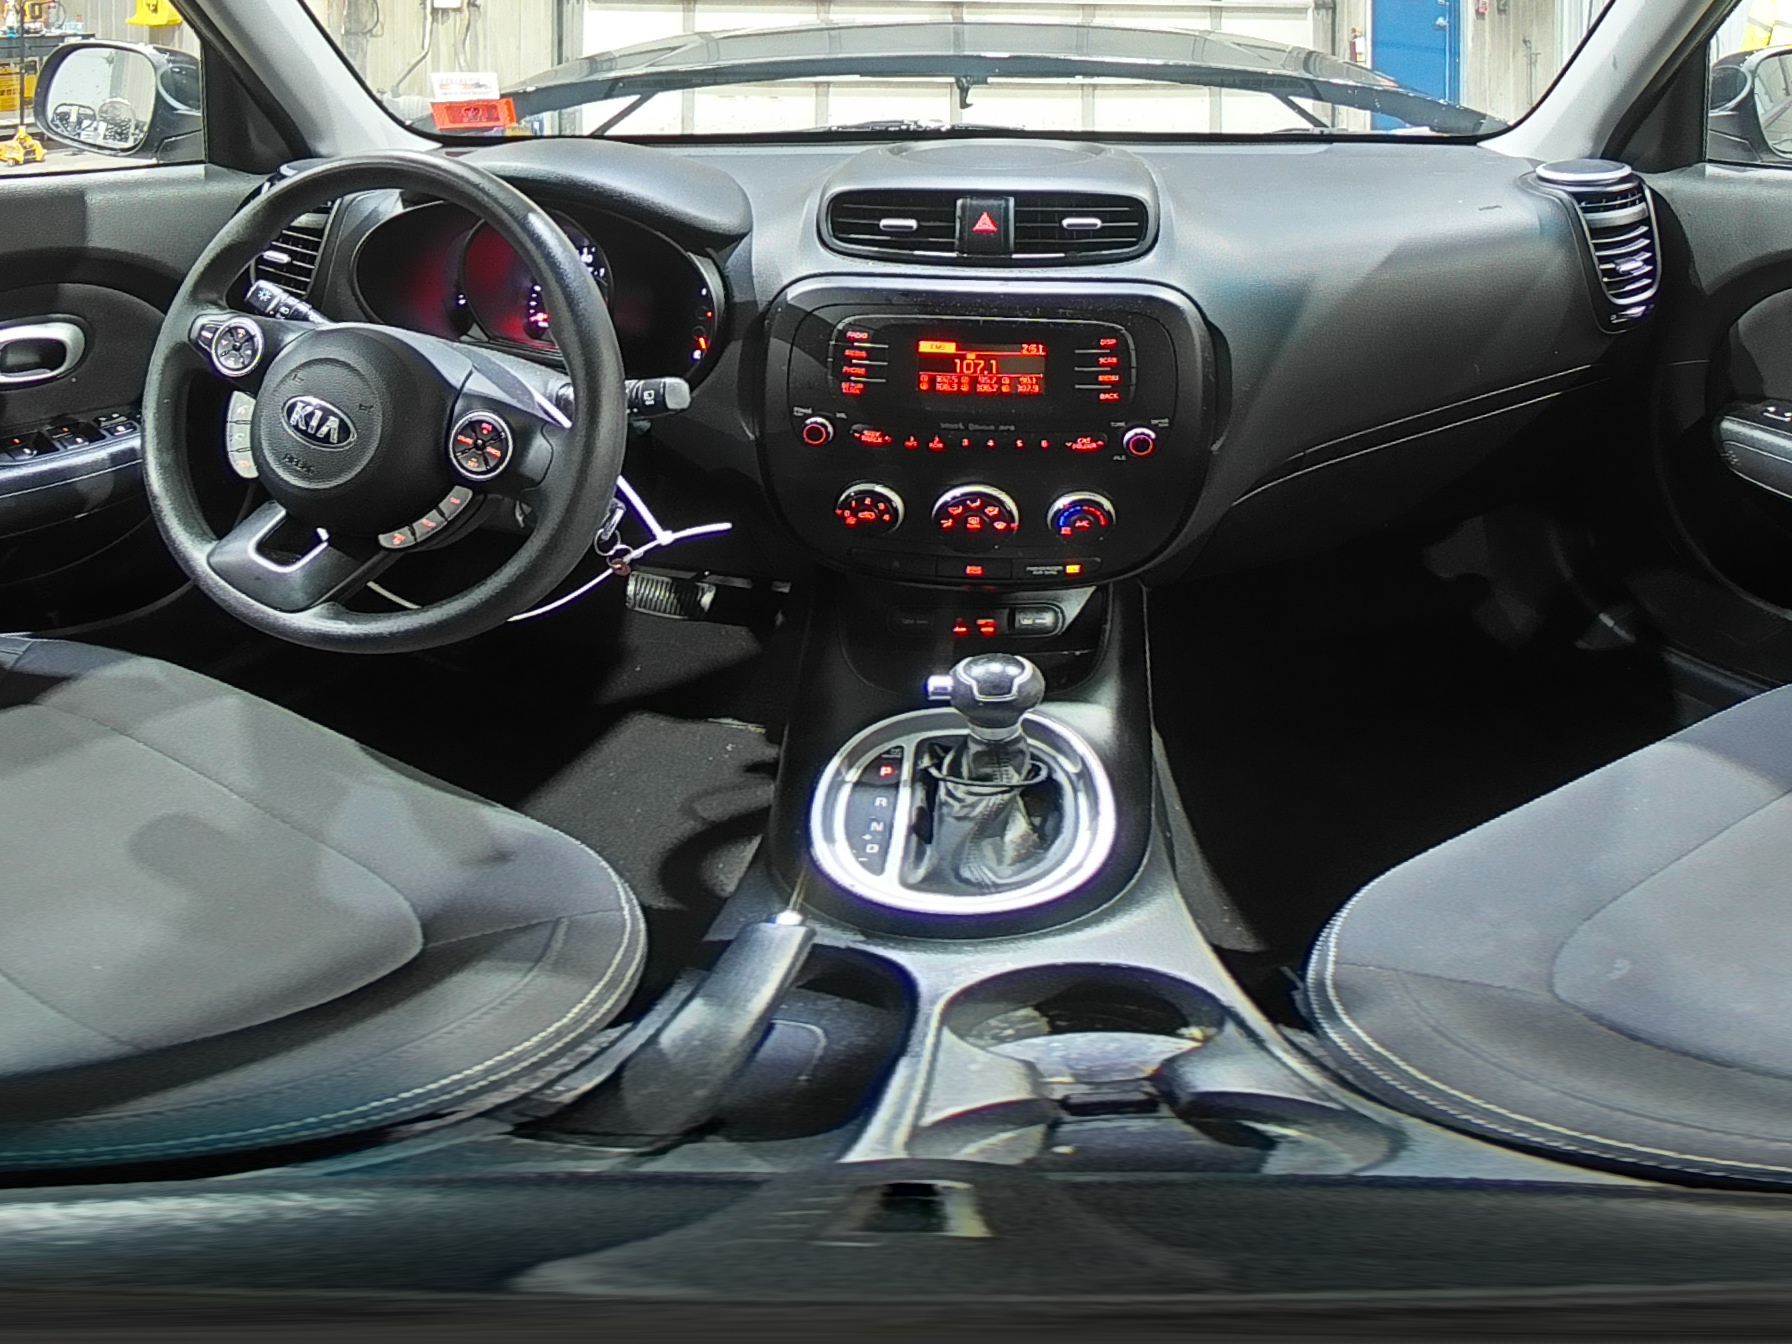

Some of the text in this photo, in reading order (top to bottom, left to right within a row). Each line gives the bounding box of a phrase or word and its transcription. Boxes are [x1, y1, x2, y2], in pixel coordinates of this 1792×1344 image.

[954, 358, 997, 375] 107.1
[289, 401, 340, 444] KIA
[879, 765, 893, 777] P
[873, 796, 888, 808] R
[869, 820, 885, 832] N
[865, 843, 880, 854] D
